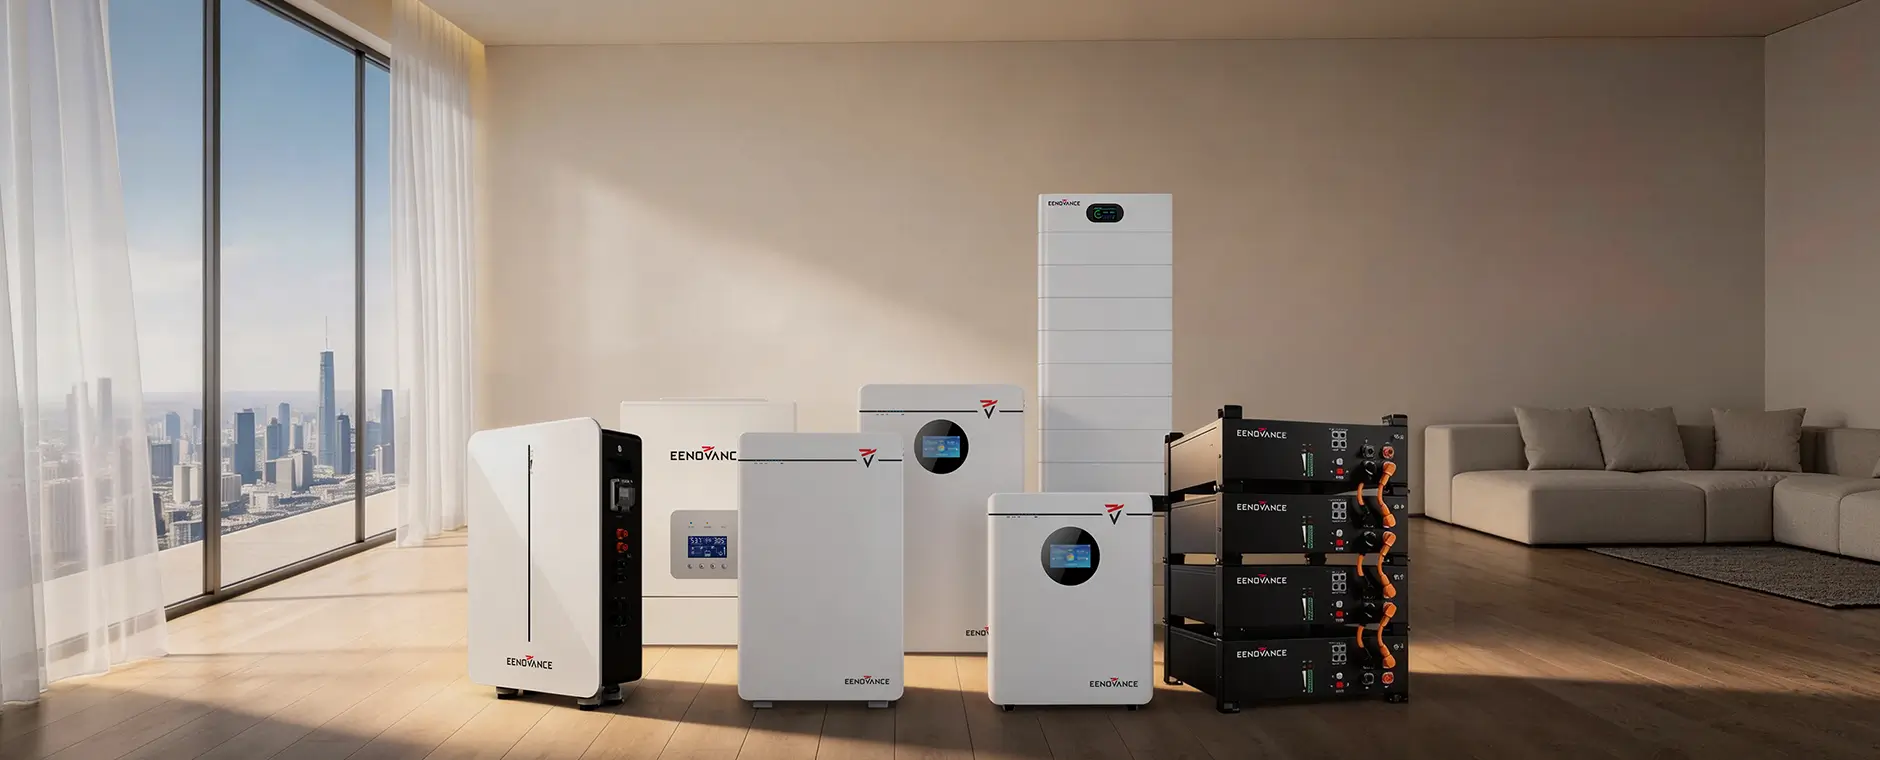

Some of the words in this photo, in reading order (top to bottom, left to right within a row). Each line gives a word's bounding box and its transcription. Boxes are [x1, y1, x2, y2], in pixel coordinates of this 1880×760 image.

[1048, 199, 1081, 207] EENOVANCE
[1236, 427, 1288, 439] EENOVANCE
[1236, 500, 1288, 512] EENOVANCE
[1236, 573, 1288, 585] EENOVANCE
[1236, 647, 1288, 659] EENOVANCE
[506, 655, 553, 670] EENOVANCE
[844, 676, 890, 685] EENOVANCE
[1089, 678, 1139, 688] EENOVANCE
